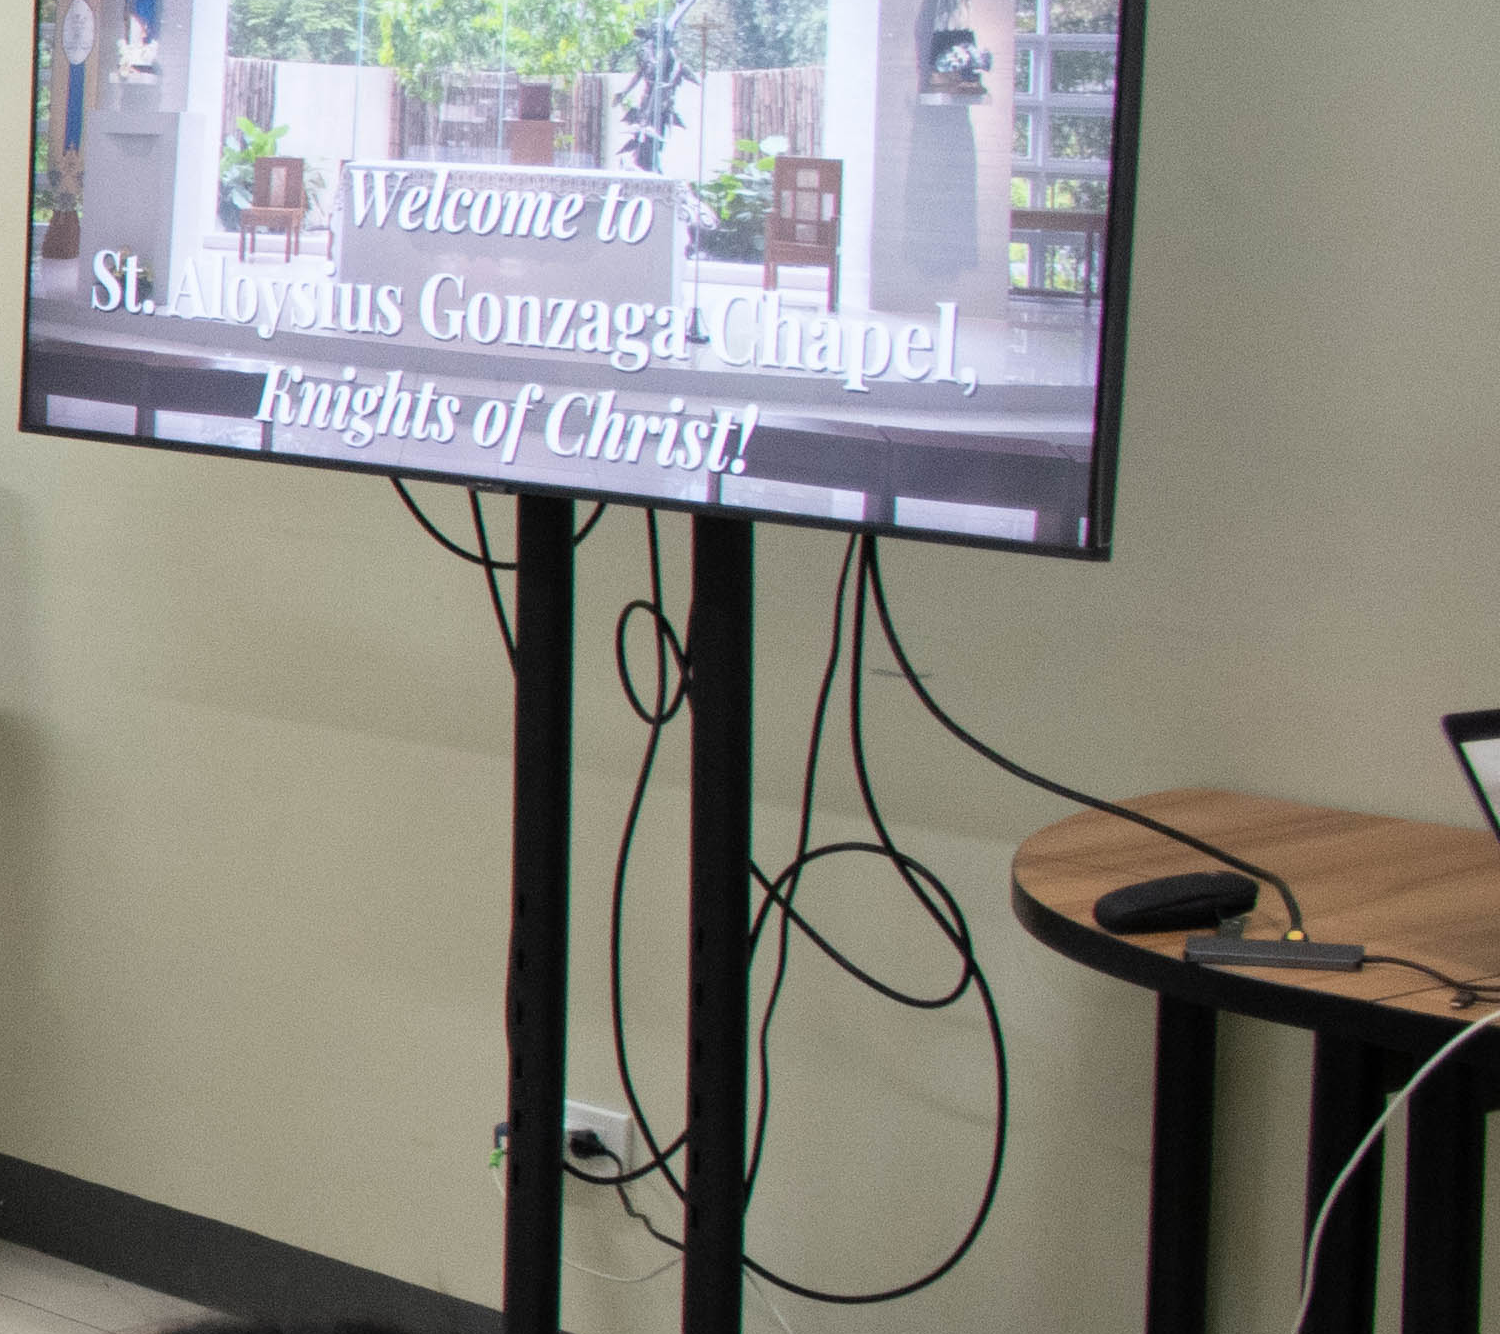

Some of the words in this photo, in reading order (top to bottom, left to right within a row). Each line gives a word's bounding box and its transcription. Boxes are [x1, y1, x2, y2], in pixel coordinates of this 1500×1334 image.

[350, 169, 583, 240] Welcome
[598, 183, 653, 244] to
[91, 249, 156, 315] St.
[168, 254, 403, 340] Aloysius
[419, 273, 690, 373] Gonzaga
[708, 289, 979, 397] Chapel,
[254, 363, 461, 448] Knights
[472, 383, 543, 463] of
[544, 390, 760, 475] Christ!
